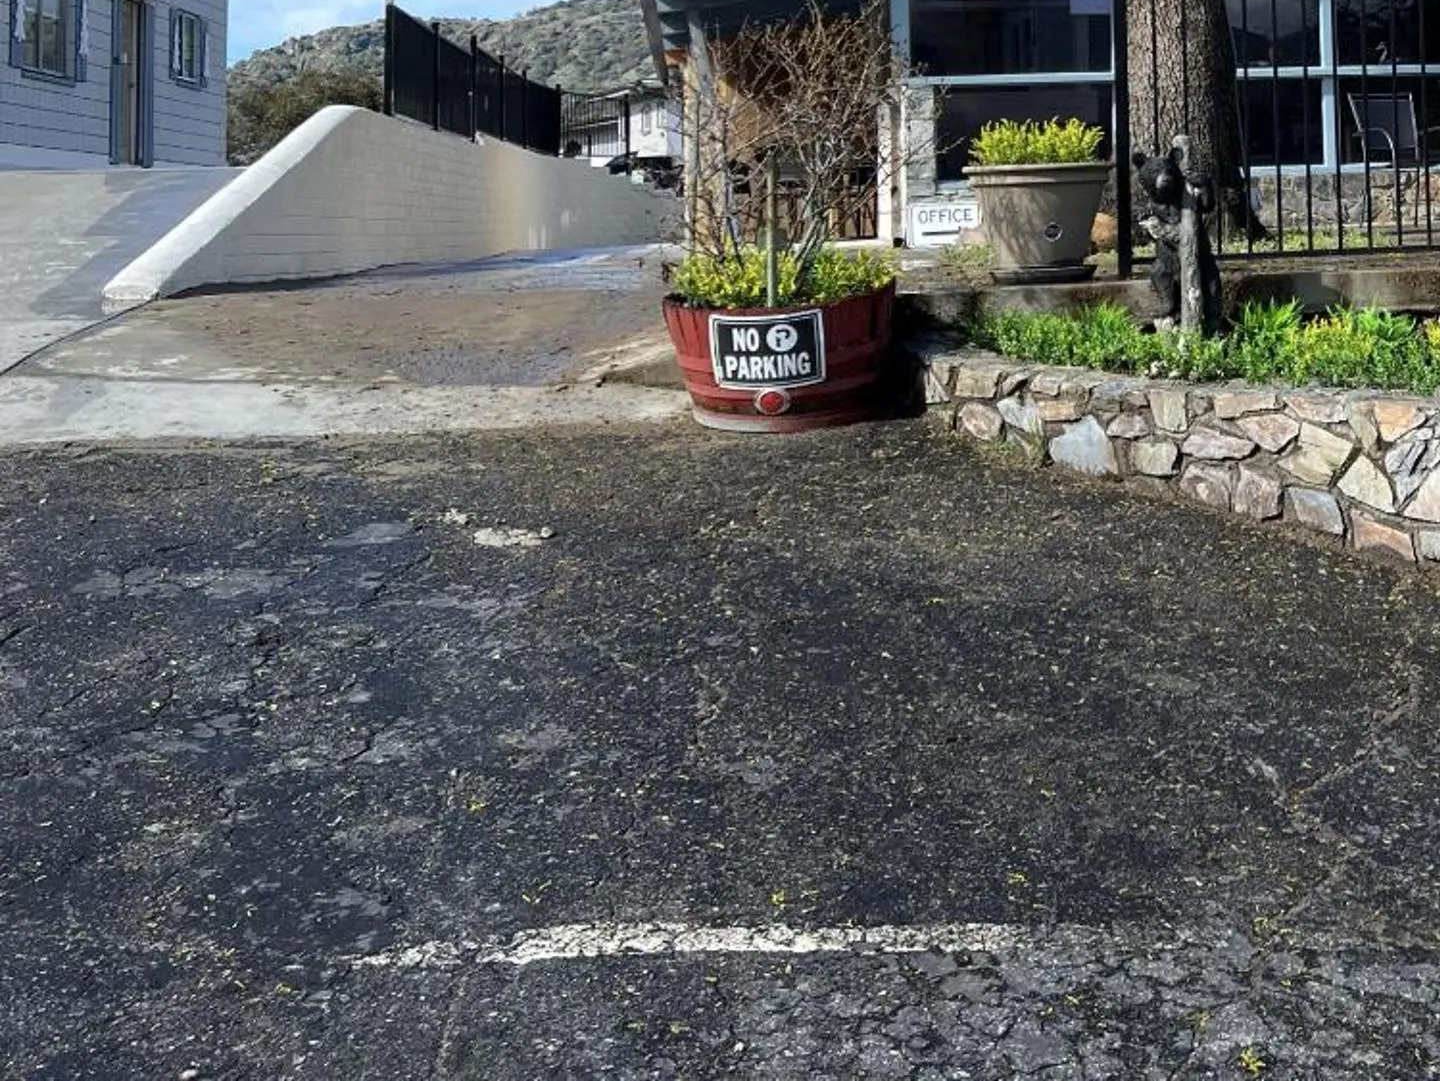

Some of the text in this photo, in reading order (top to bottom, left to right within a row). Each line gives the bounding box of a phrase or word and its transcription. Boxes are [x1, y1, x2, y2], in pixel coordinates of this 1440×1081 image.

[918, 207, 974, 225] OFFICE
[731, 327, 760, 352] NO
[723, 351, 812, 380] PARKING
